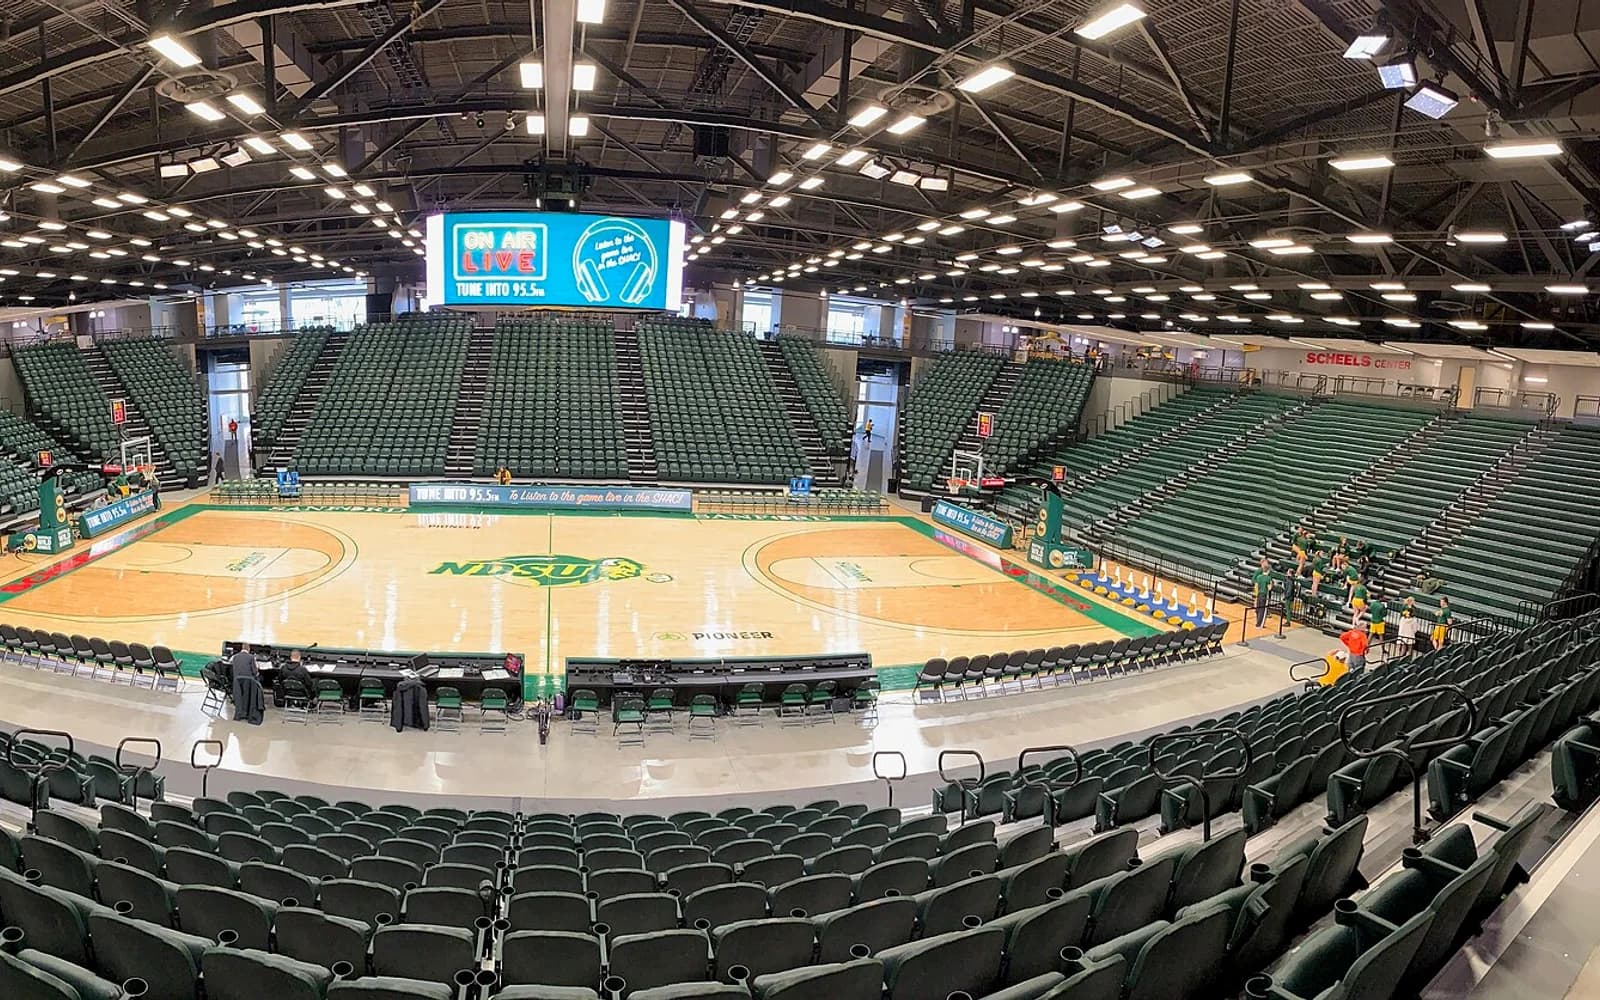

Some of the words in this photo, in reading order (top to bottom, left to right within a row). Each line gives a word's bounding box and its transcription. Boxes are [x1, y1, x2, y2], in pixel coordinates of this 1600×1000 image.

[464, 231, 494, 250] ON
[501, 231, 537, 250] AIR
[463, 251, 536, 273] LIVE
[456, 282, 483, 297] TUNE
[485, 282, 509, 297] INTO
[1307, 353, 1371, 367] SCHEELS
[1375, 360, 1410, 369] CENTER
[416, 488, 440, 501] TUNE
[444, 488, 467, 501] INTO
[509, 490, 519, 500] To
[520, 490, 547, 501] Listen
[549, 491, 558, 501] to
[560, 491, 576, 501] the
[576, 494, 603, 505] game
[605, 491, 622, 502] live
[623, 494, 634, 503] in
[635, 492, 650, 503] the
[427, 561, 592, 579] NDSU
[692, 632, 774, 640] PIONEER
